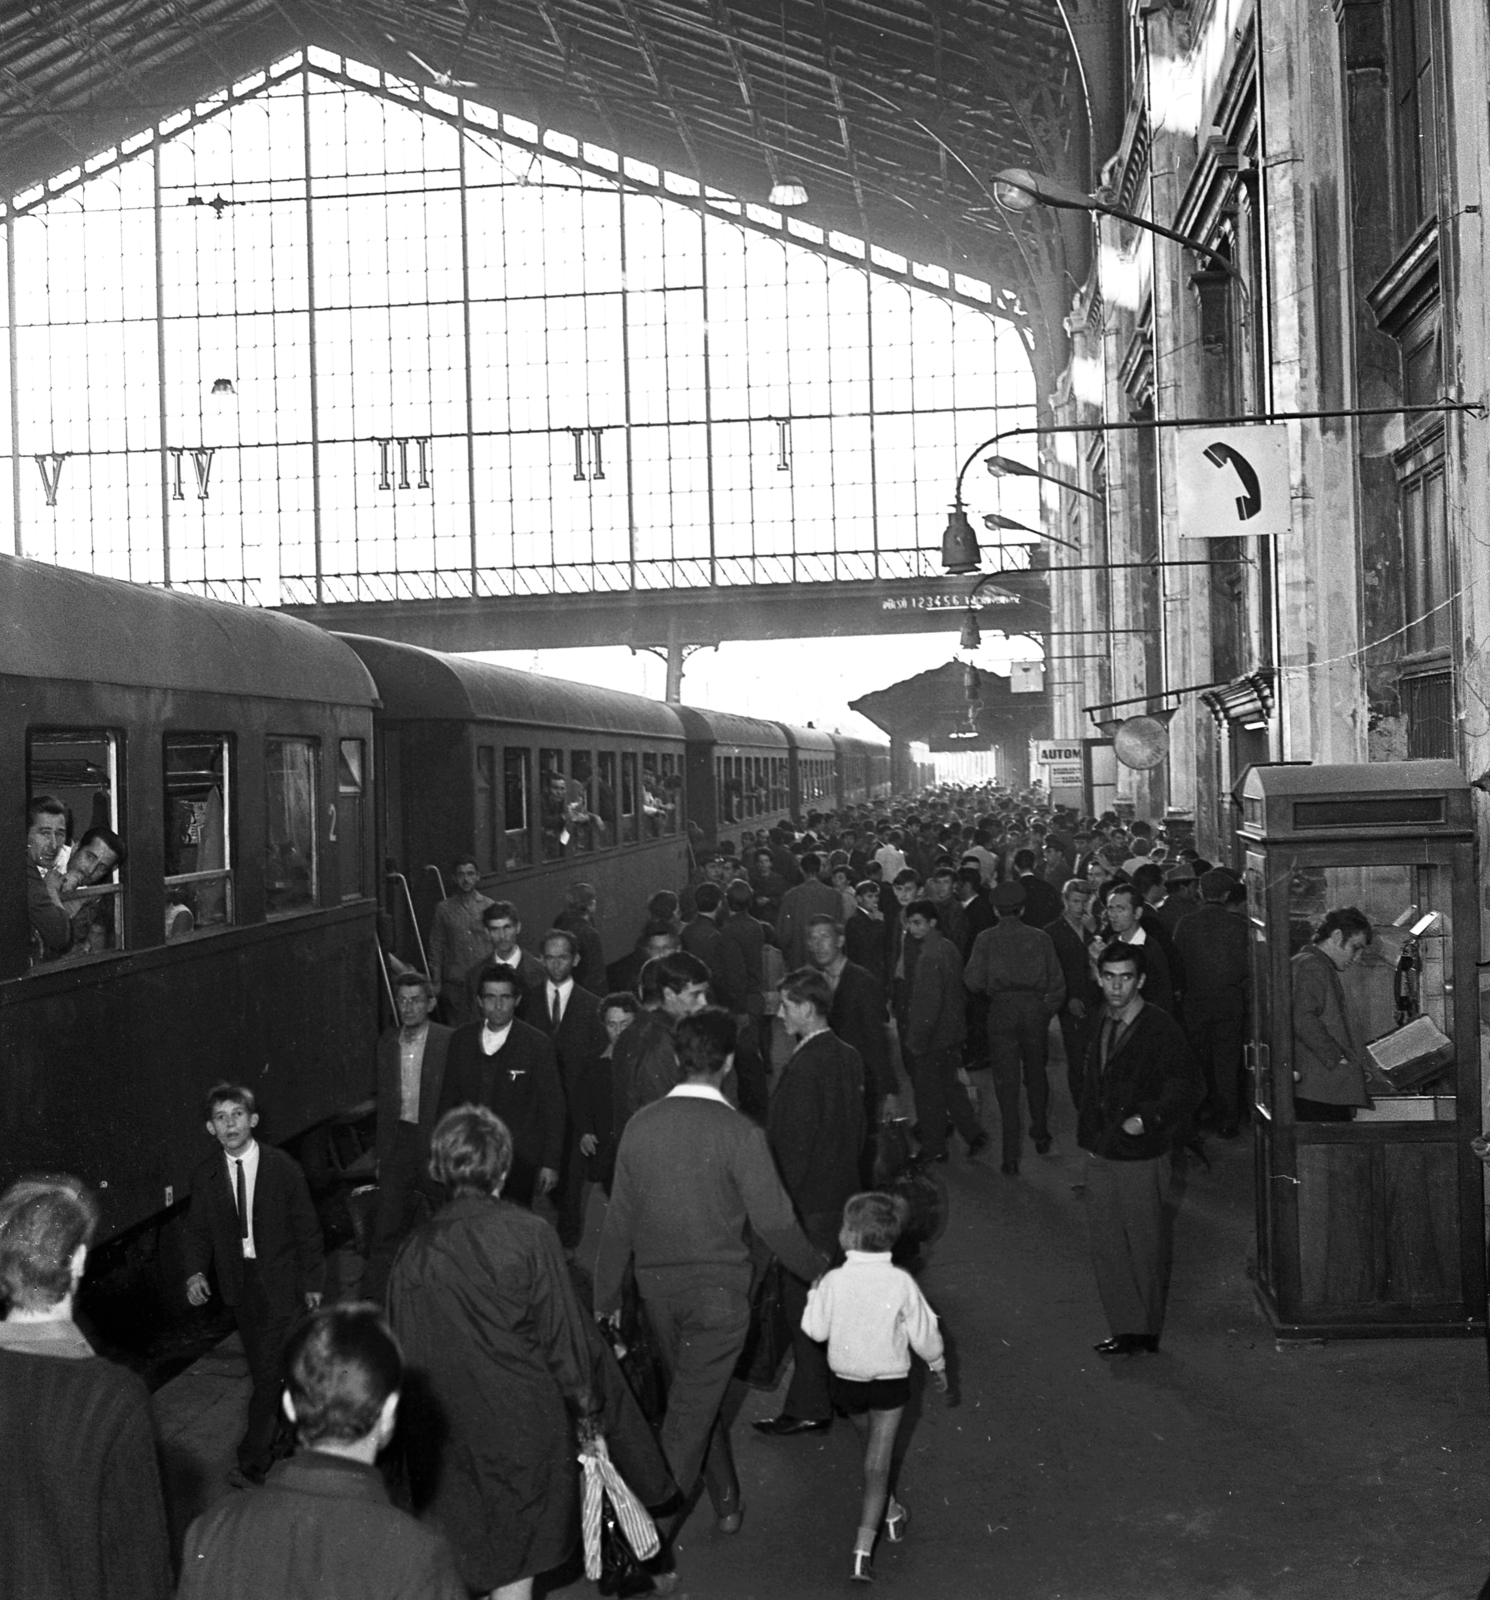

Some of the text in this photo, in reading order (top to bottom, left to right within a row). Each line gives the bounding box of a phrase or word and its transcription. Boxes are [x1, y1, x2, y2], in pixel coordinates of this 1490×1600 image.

[171, 448, 215, 500] IV
[378, 438, 430, 490] III
[572, 428, 606, 481] II
[776, 419, 790, 471] I
[328, 802, 338, 842] 2
